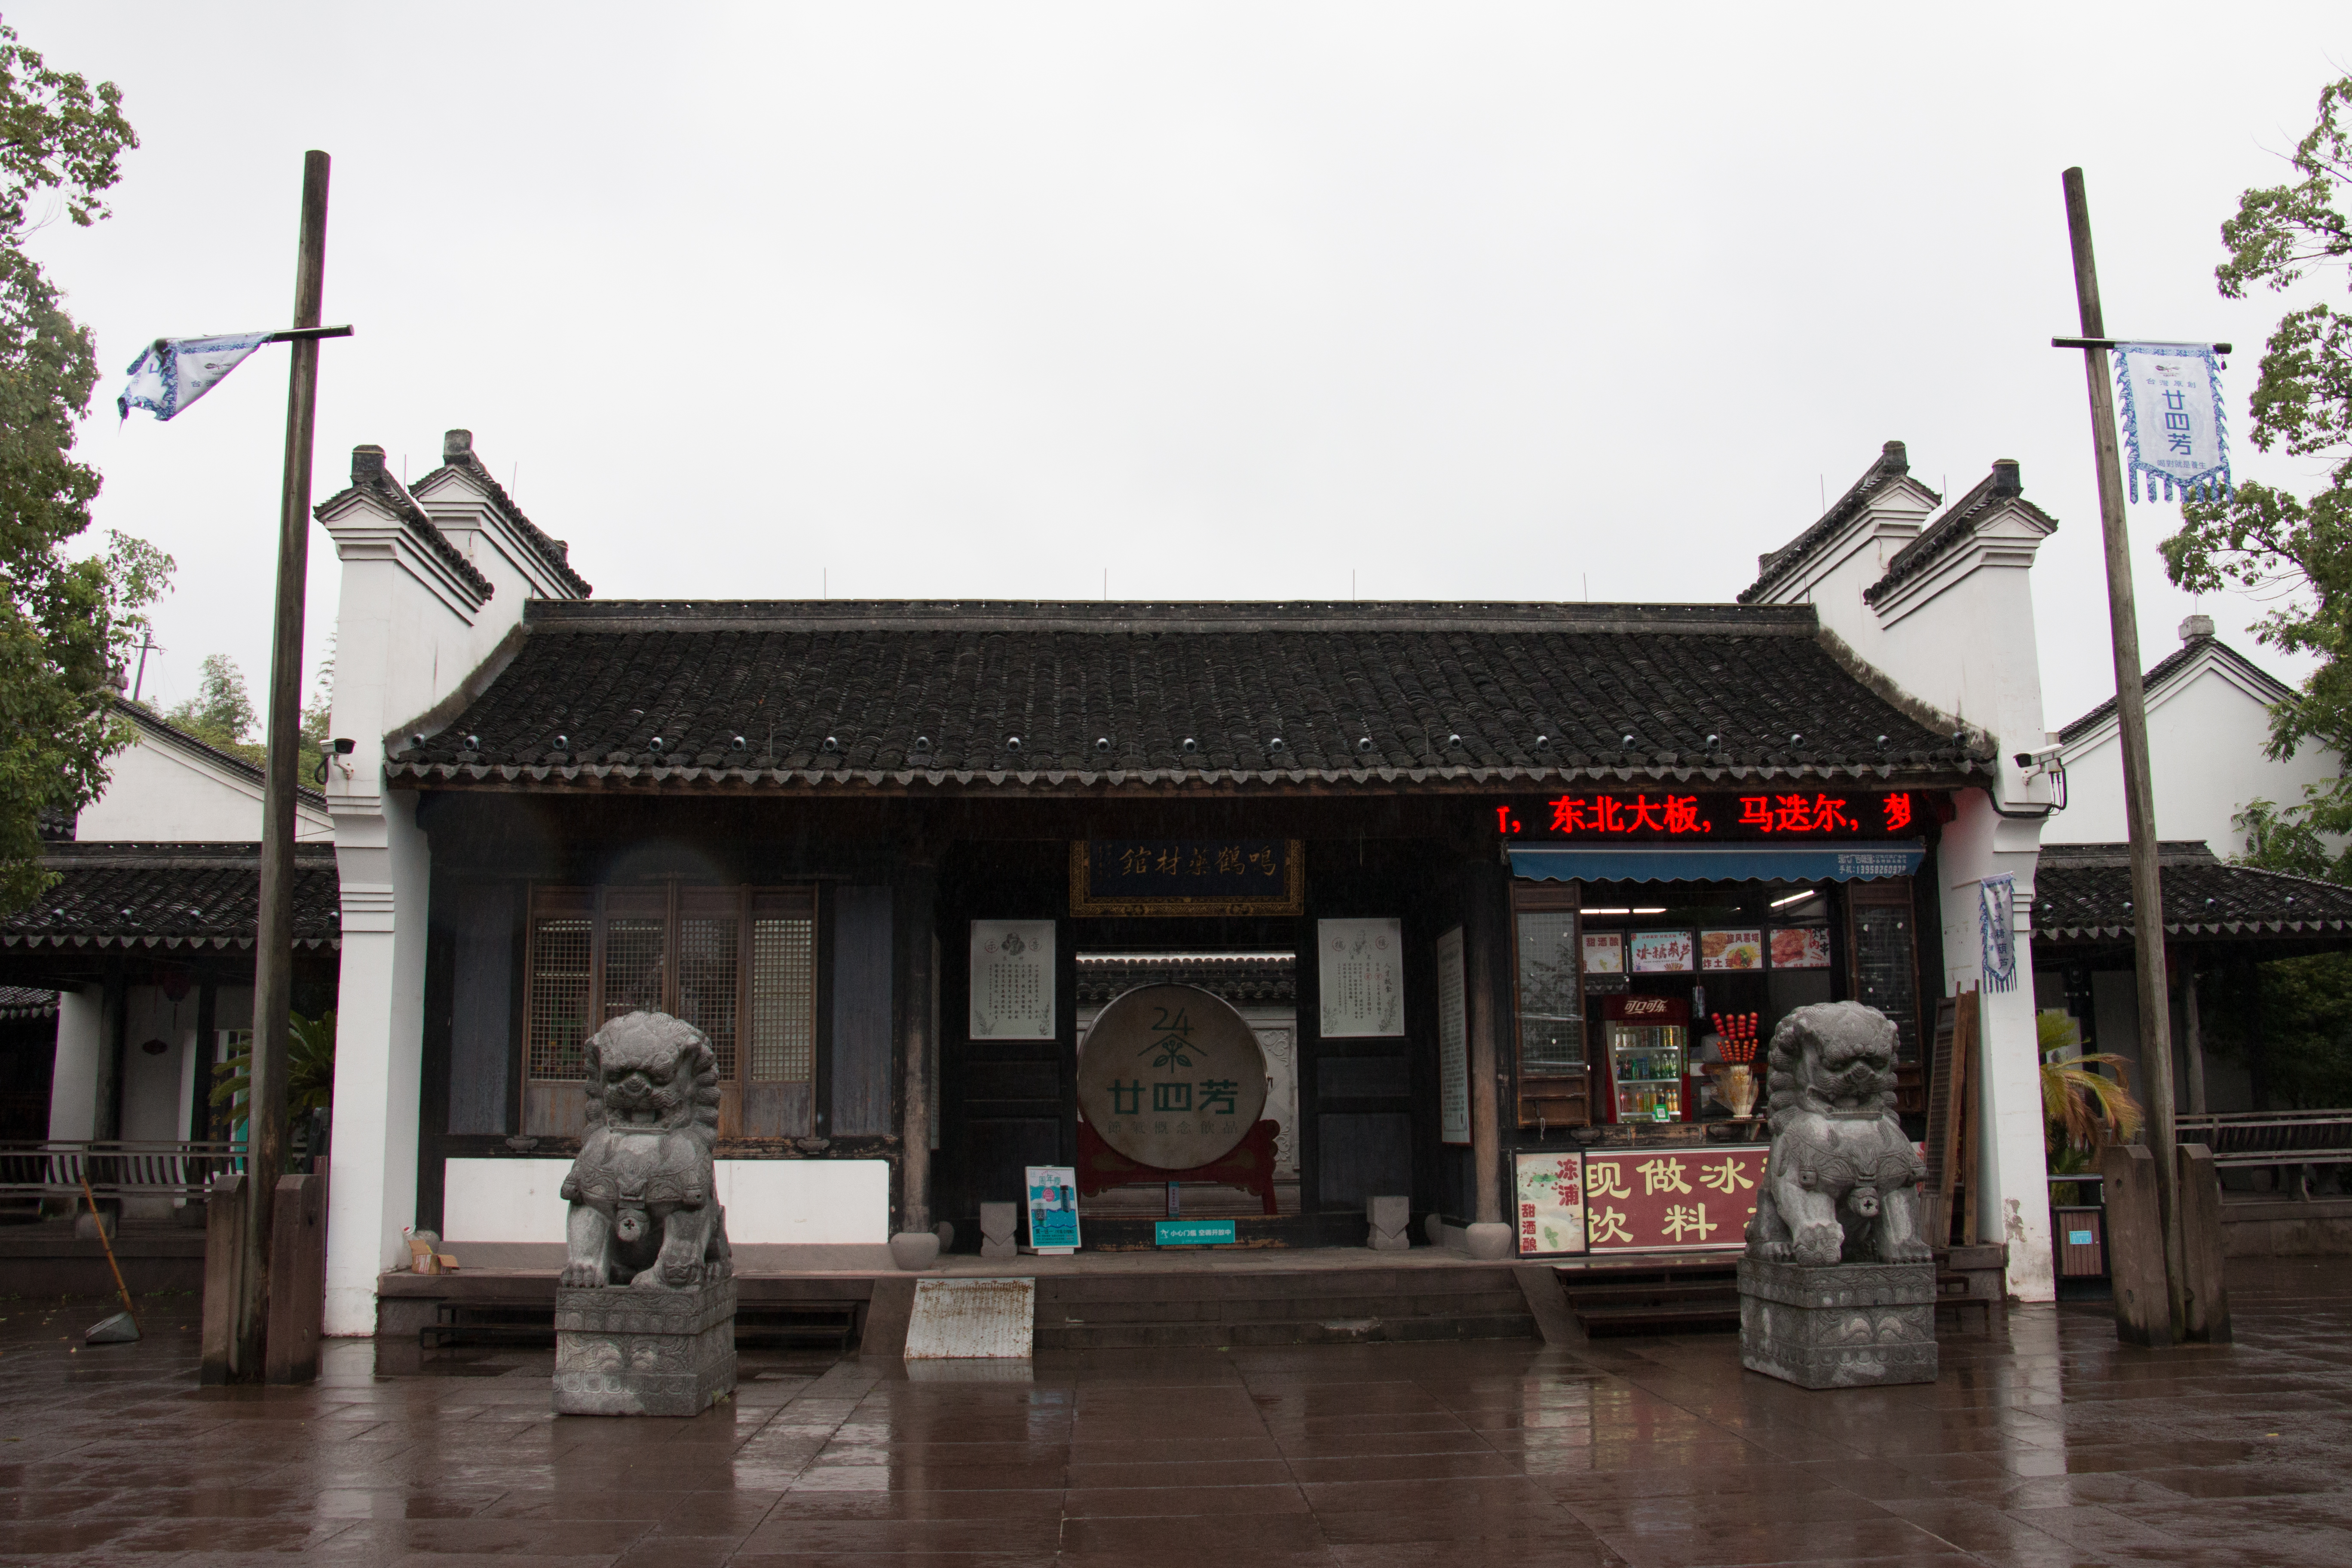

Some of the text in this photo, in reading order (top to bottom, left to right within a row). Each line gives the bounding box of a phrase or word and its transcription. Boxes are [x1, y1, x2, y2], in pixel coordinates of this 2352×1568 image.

[2146, 378, 2196, 388] 台灣原創
[2157, 459, 2206, 470] 喝對就是養生
[1586, 937, 1619, 947] 甜酒酿
[1727, 933, 1759, 945] 旋风薯塔
[1636, 940, 1691, 961] 冰糖葫芦
[1624, 998, 1669, 1014] 可口可乐
[1151, 1007, 1194, 1036] 24
[1107, 1079, 1238, 1115] 廿四芳
[1107, 1121, 1238, 1135] 節氣概念飲品
[1586, 1157, 1767, 1199] 现做冰
[1522, 1204, 1537, 1252] 甜酒酿
[1588, 1203, 1757, 1243] 饮料
